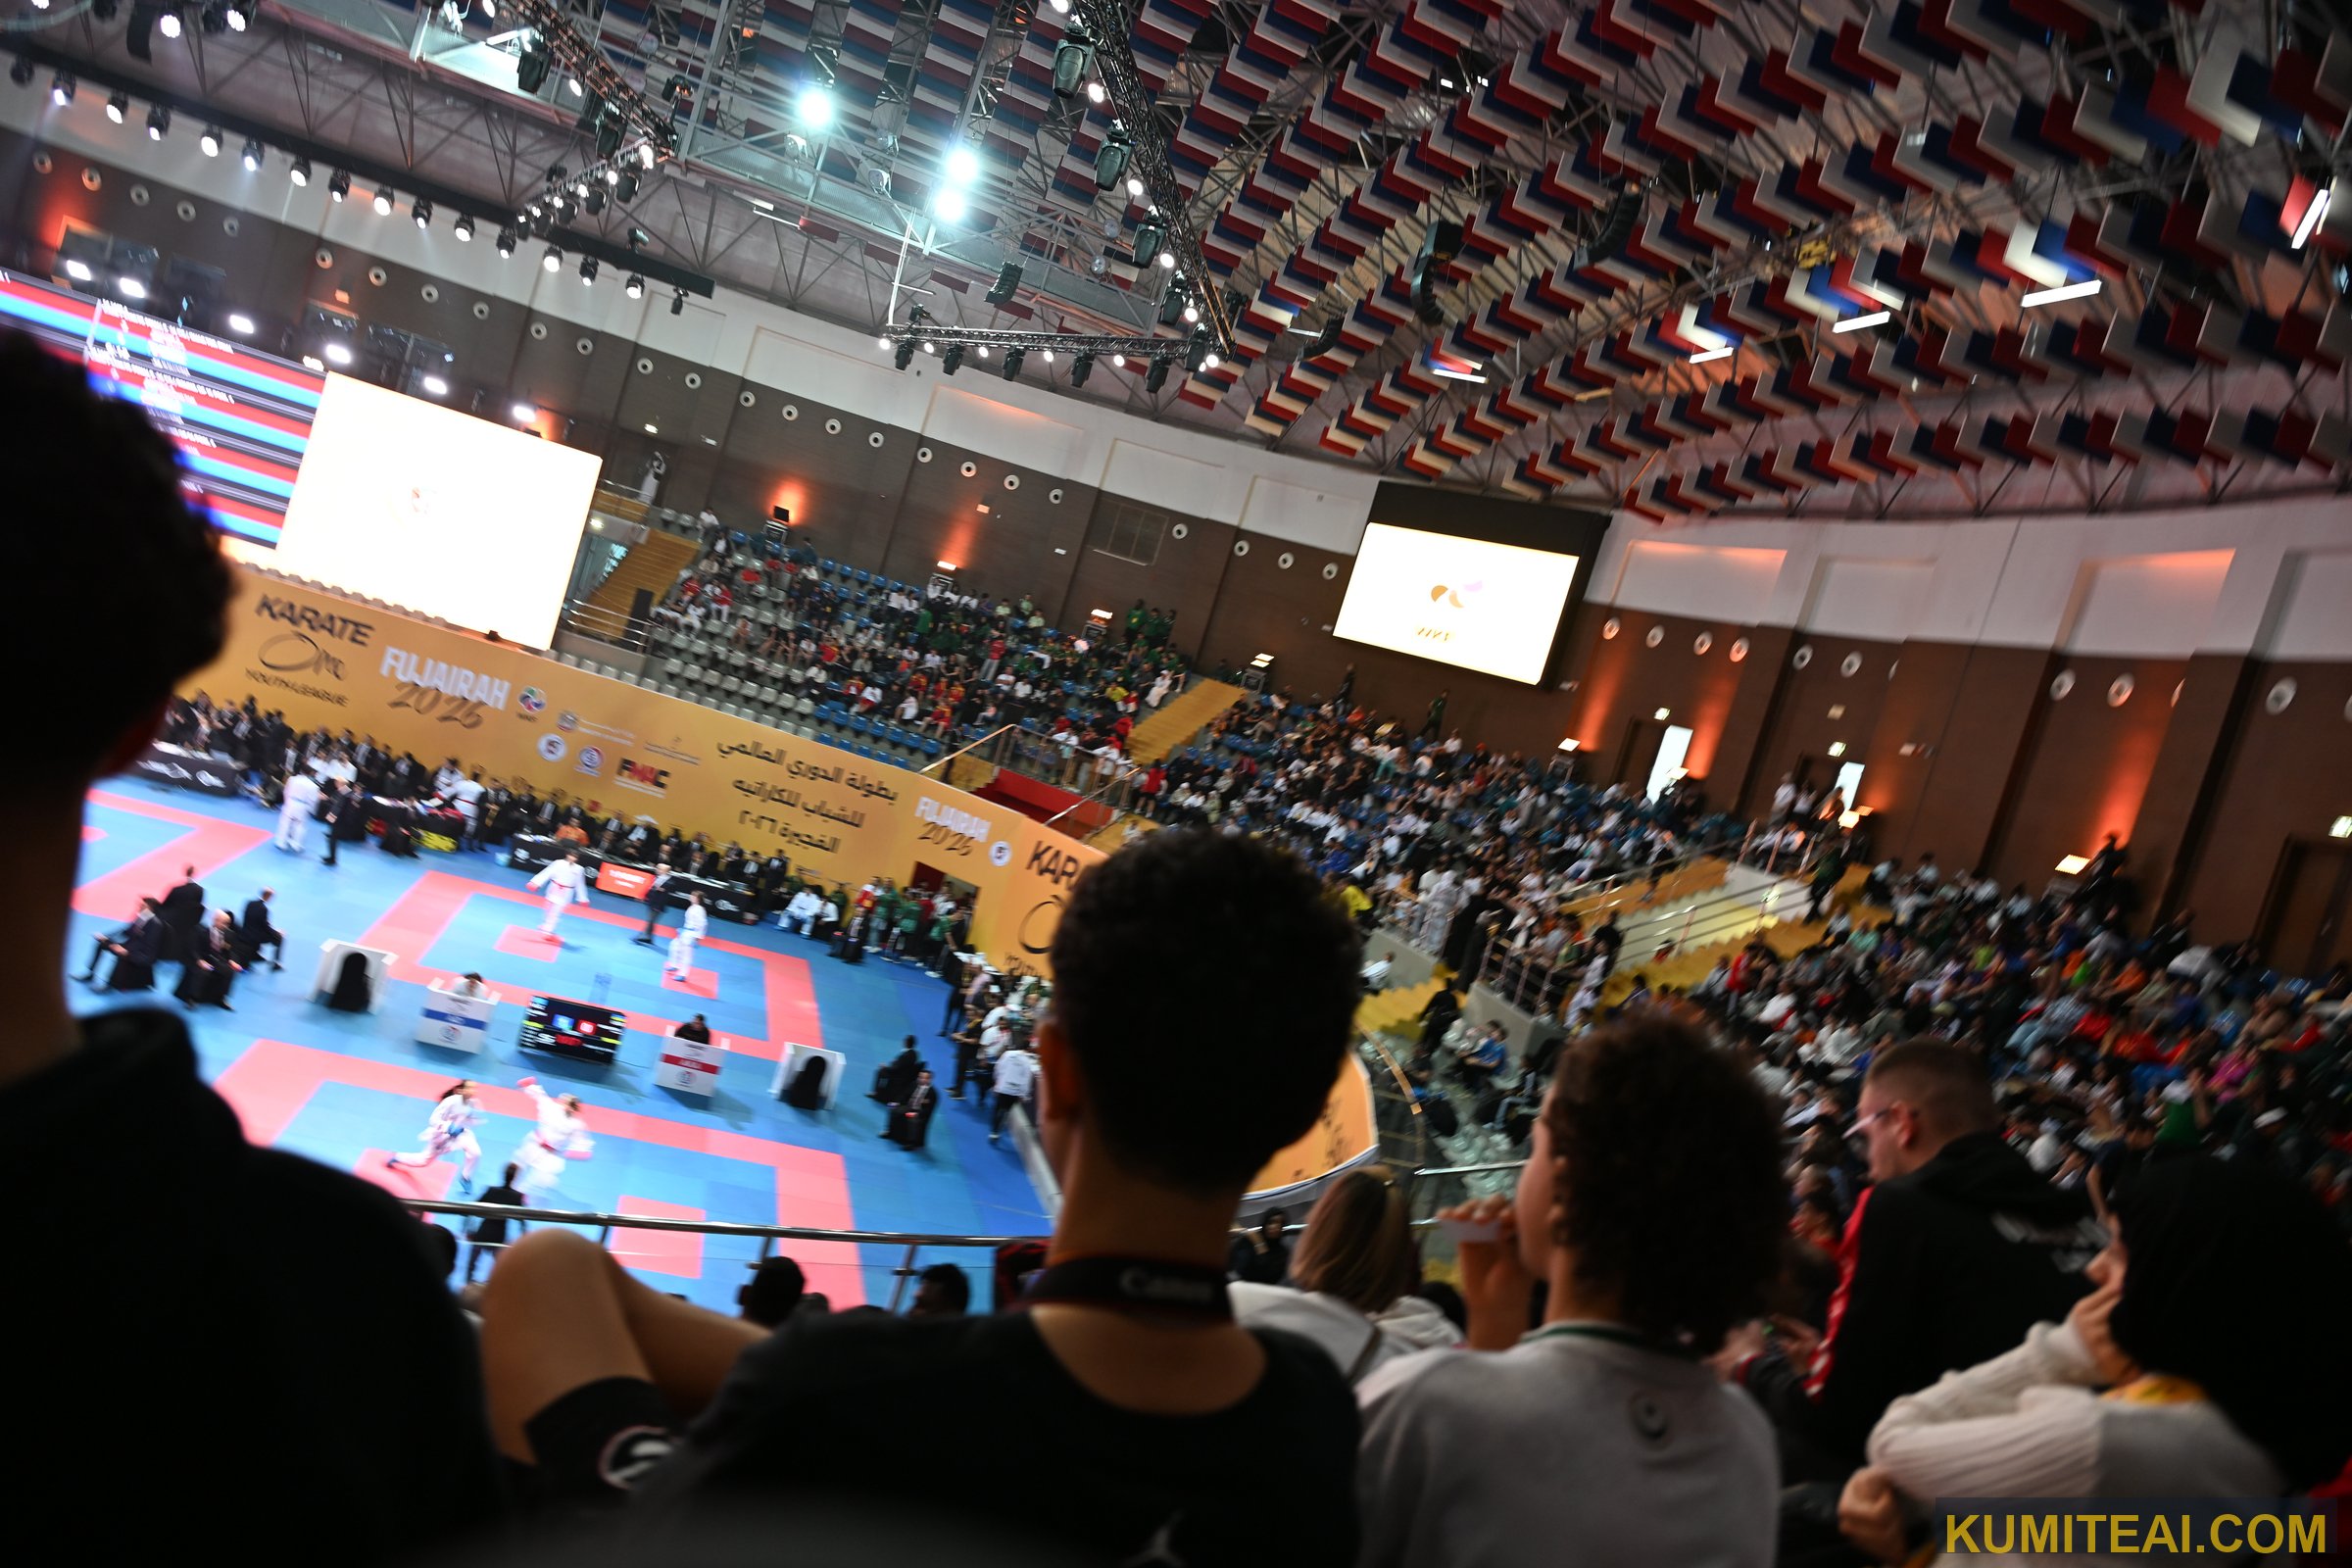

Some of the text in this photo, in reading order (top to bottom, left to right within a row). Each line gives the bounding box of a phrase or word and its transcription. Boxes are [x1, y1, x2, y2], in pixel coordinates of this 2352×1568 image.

[256, 594, 374, 647] KARATE
[379, 645, 512, 711] FUJAIRAH
[717, 740, 787, 765] العالمي
[786, 760, 845, 784] الدوري
[846, 772, 899, 806] بطولة
[802, 800, 866, 828] للشباب
[915, 796, 992, 843] FUJAIRAH
[1026, 840, 1082, 892] KAR
